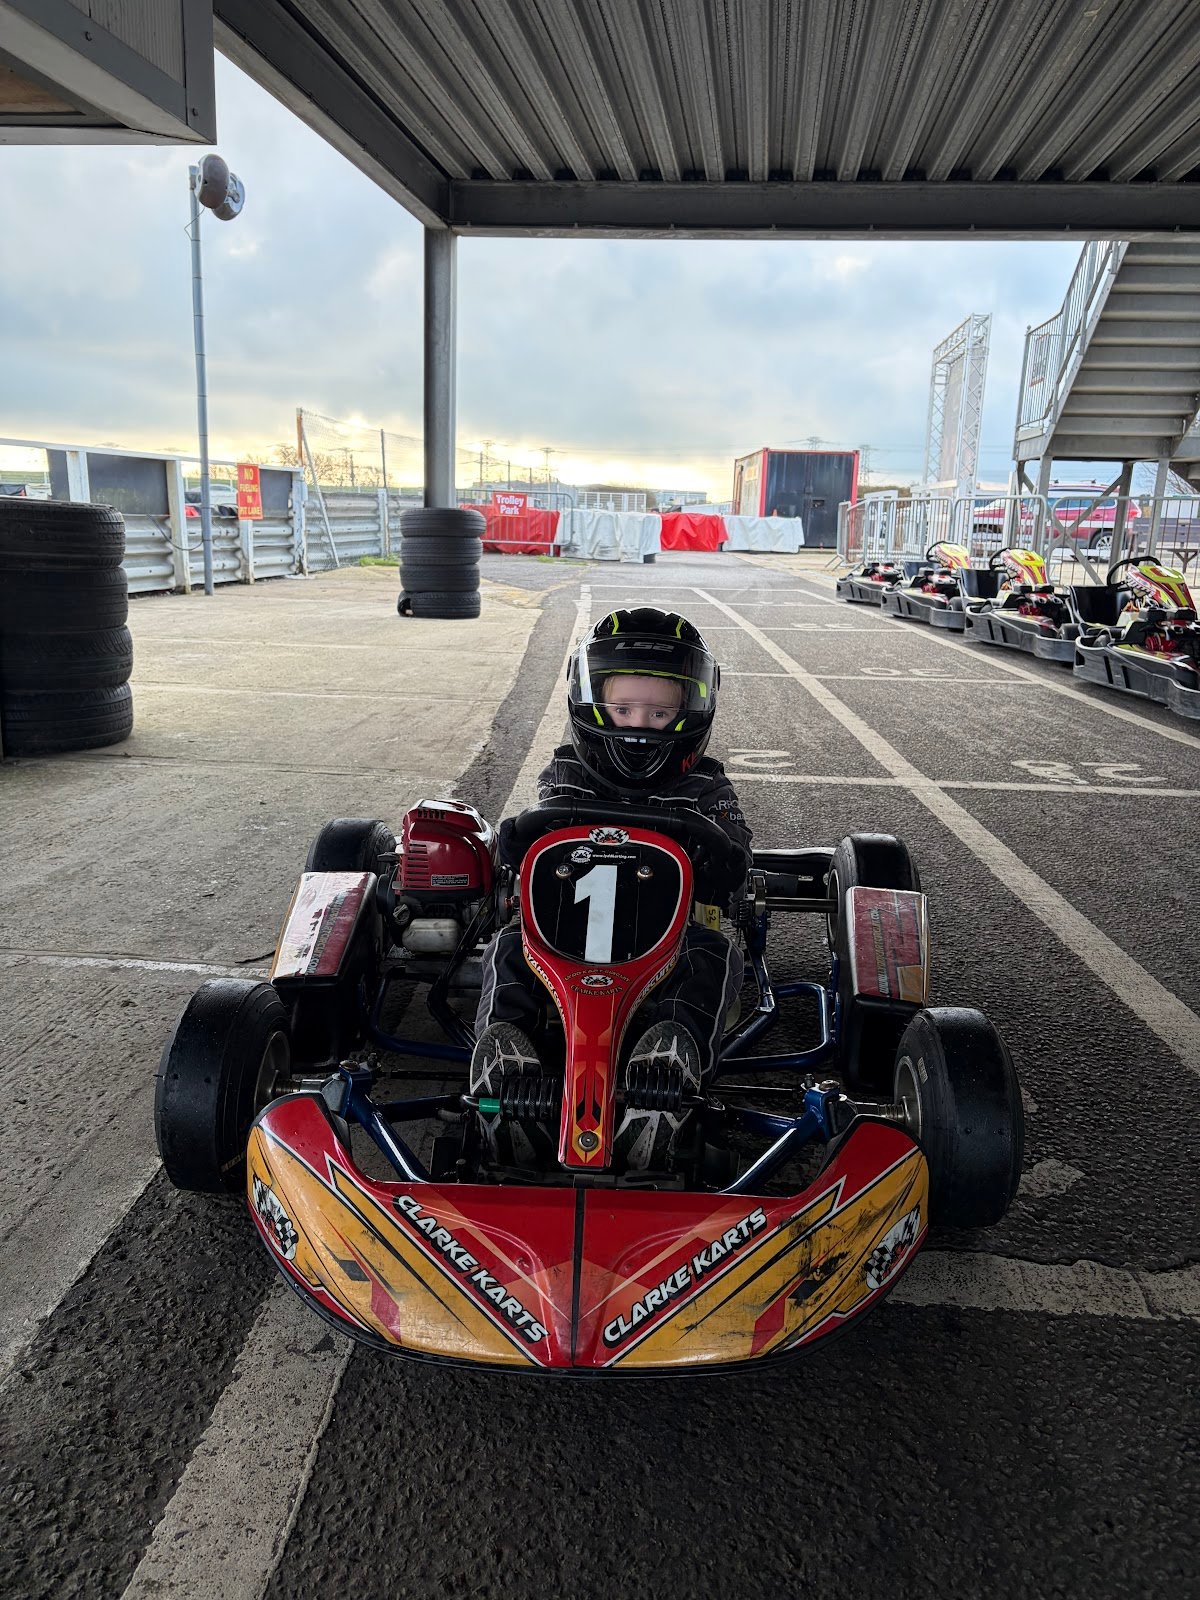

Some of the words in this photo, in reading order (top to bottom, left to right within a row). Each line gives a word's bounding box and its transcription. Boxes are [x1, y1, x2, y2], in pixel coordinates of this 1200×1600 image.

[243, 468, 254, 481] NO
[495, 494, 525, 507] Trolley
[239, 506, 247, 515] PIT
[248, 506, 261, 515] LANE
[500, 504, 520, 515] Park
[615, 641, 675, 653] LS2
[574, 864, 618, 964] 1
[397, 1194, 479, 1272] CLARKE
[470, 1269, 550, 1343] KARTS
[603, 1265, 691, 1343] CLARKE
[692, 1207, 767, 1275] KARTS
